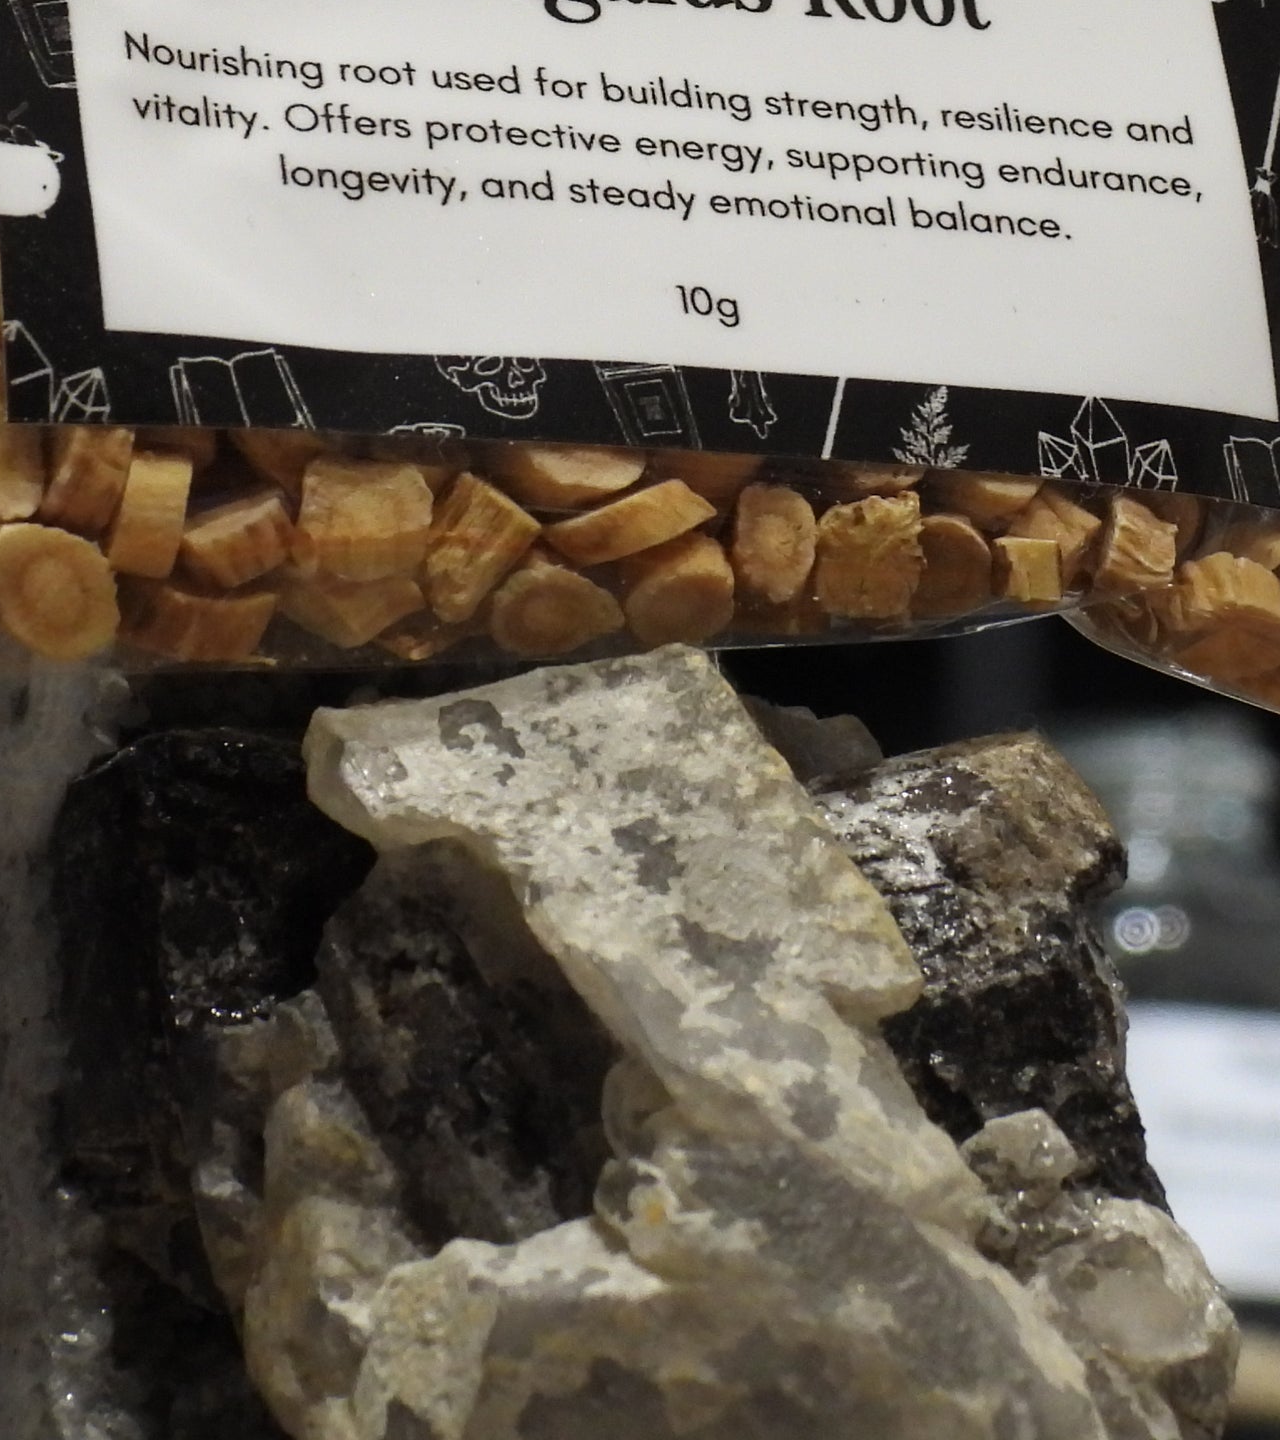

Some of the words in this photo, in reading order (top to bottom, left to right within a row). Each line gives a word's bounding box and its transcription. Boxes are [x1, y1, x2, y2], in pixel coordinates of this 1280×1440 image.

[124, 30, 324, 90] Nourishing
[339, 60, 417, 86] root
[431, 64, 521, 95] used
[534, 66, 588, 100] for
[600, 71, 752, 122] building
[764, 90, 928, 132] strength,
[940, 102, 1113, 140] resilience
[1126, 114, 1194, 145] and
[132, 93, 270, 140] vitality.
[284, 102, 412, 139] Offers
[425, 120, 621, 154] protective
[635, 137, 774, 174] energy,
[786, 148, 985, 190] supporting
[998, 156, 1203, 203] endurance,
[279, 152, 468, 207] longevity,
[481, 169, 554, 202] and
[568, 178, 696, 222] steady
[709, 194, 896, 228] emotional
[907, 196, 1073, 241] balance.
[674, 284, 740, 328] 10g
